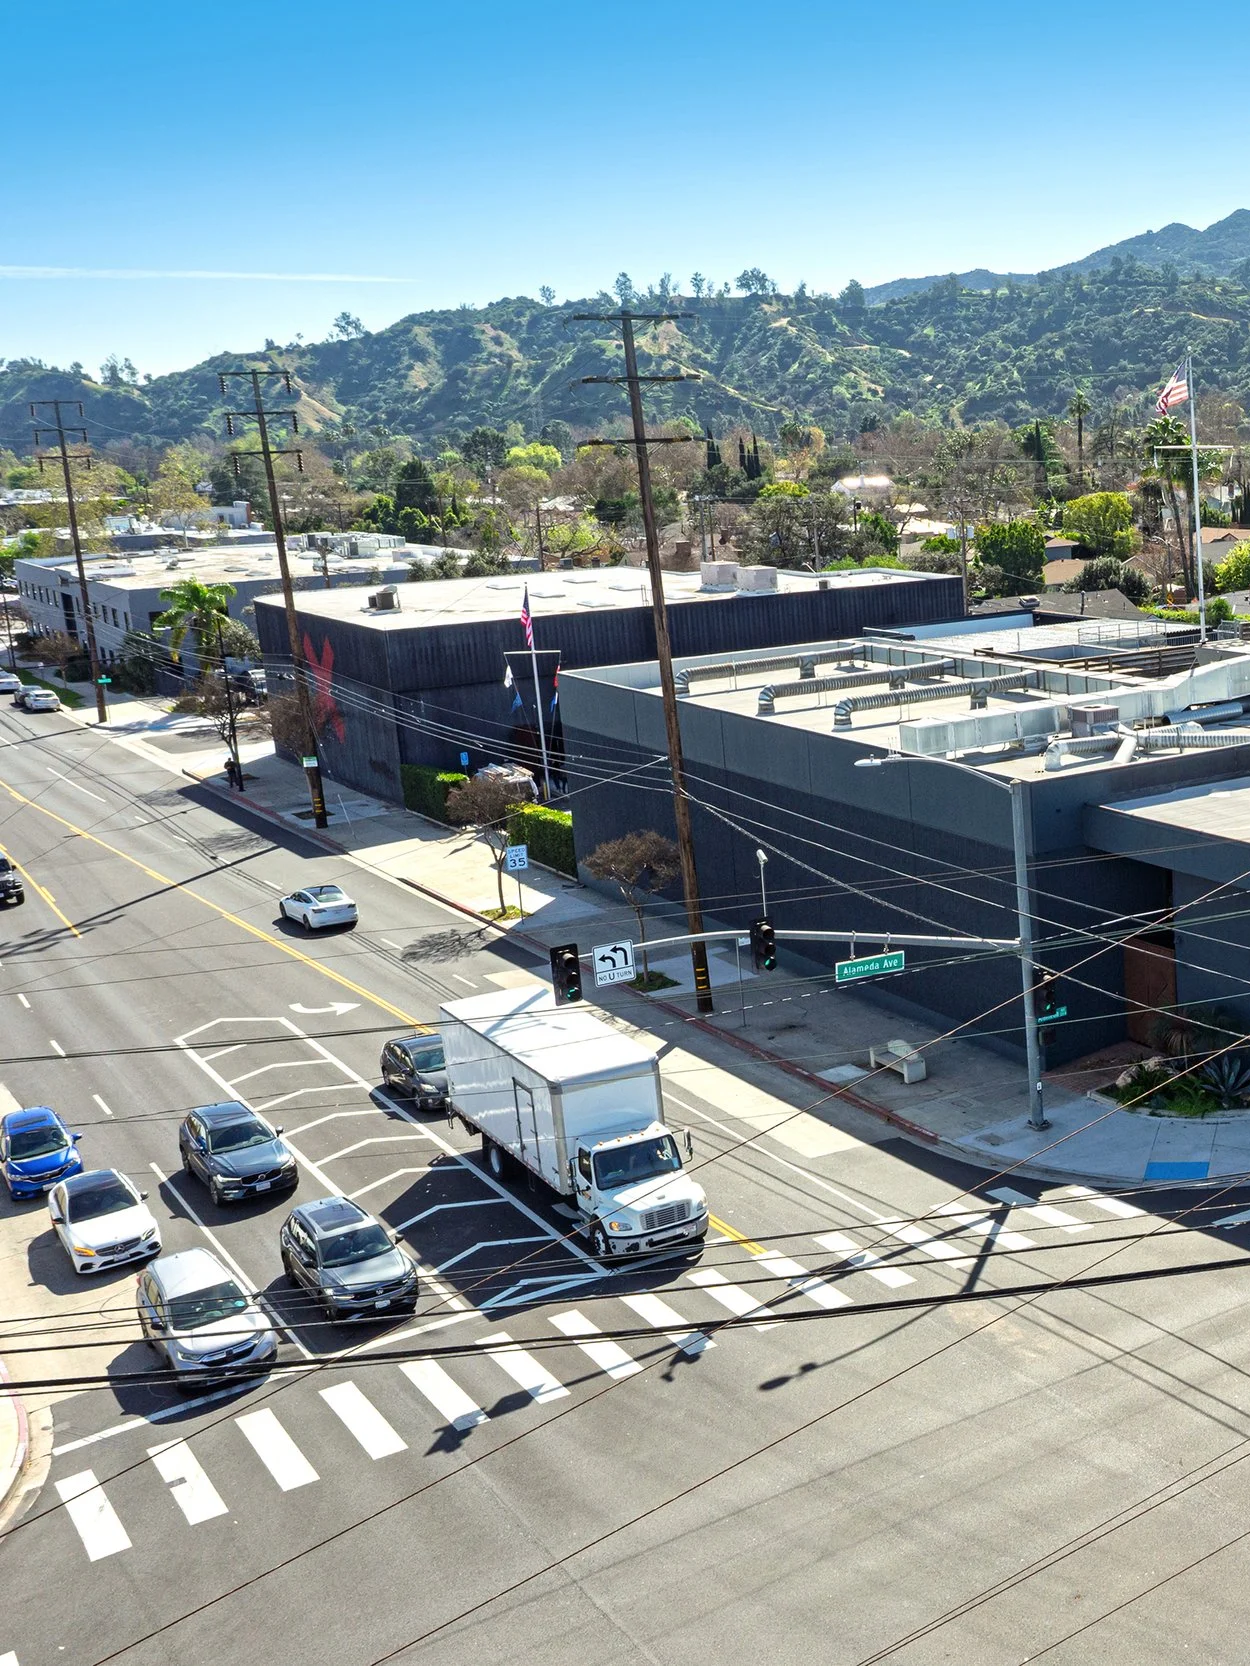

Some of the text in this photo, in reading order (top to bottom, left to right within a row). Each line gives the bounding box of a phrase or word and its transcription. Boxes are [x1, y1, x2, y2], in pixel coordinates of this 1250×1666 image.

[509, 857, 526, 868] 35
[843, 958, 898, 976] Alameda Ave
[599, 969, 632, 982] NO U TURN
